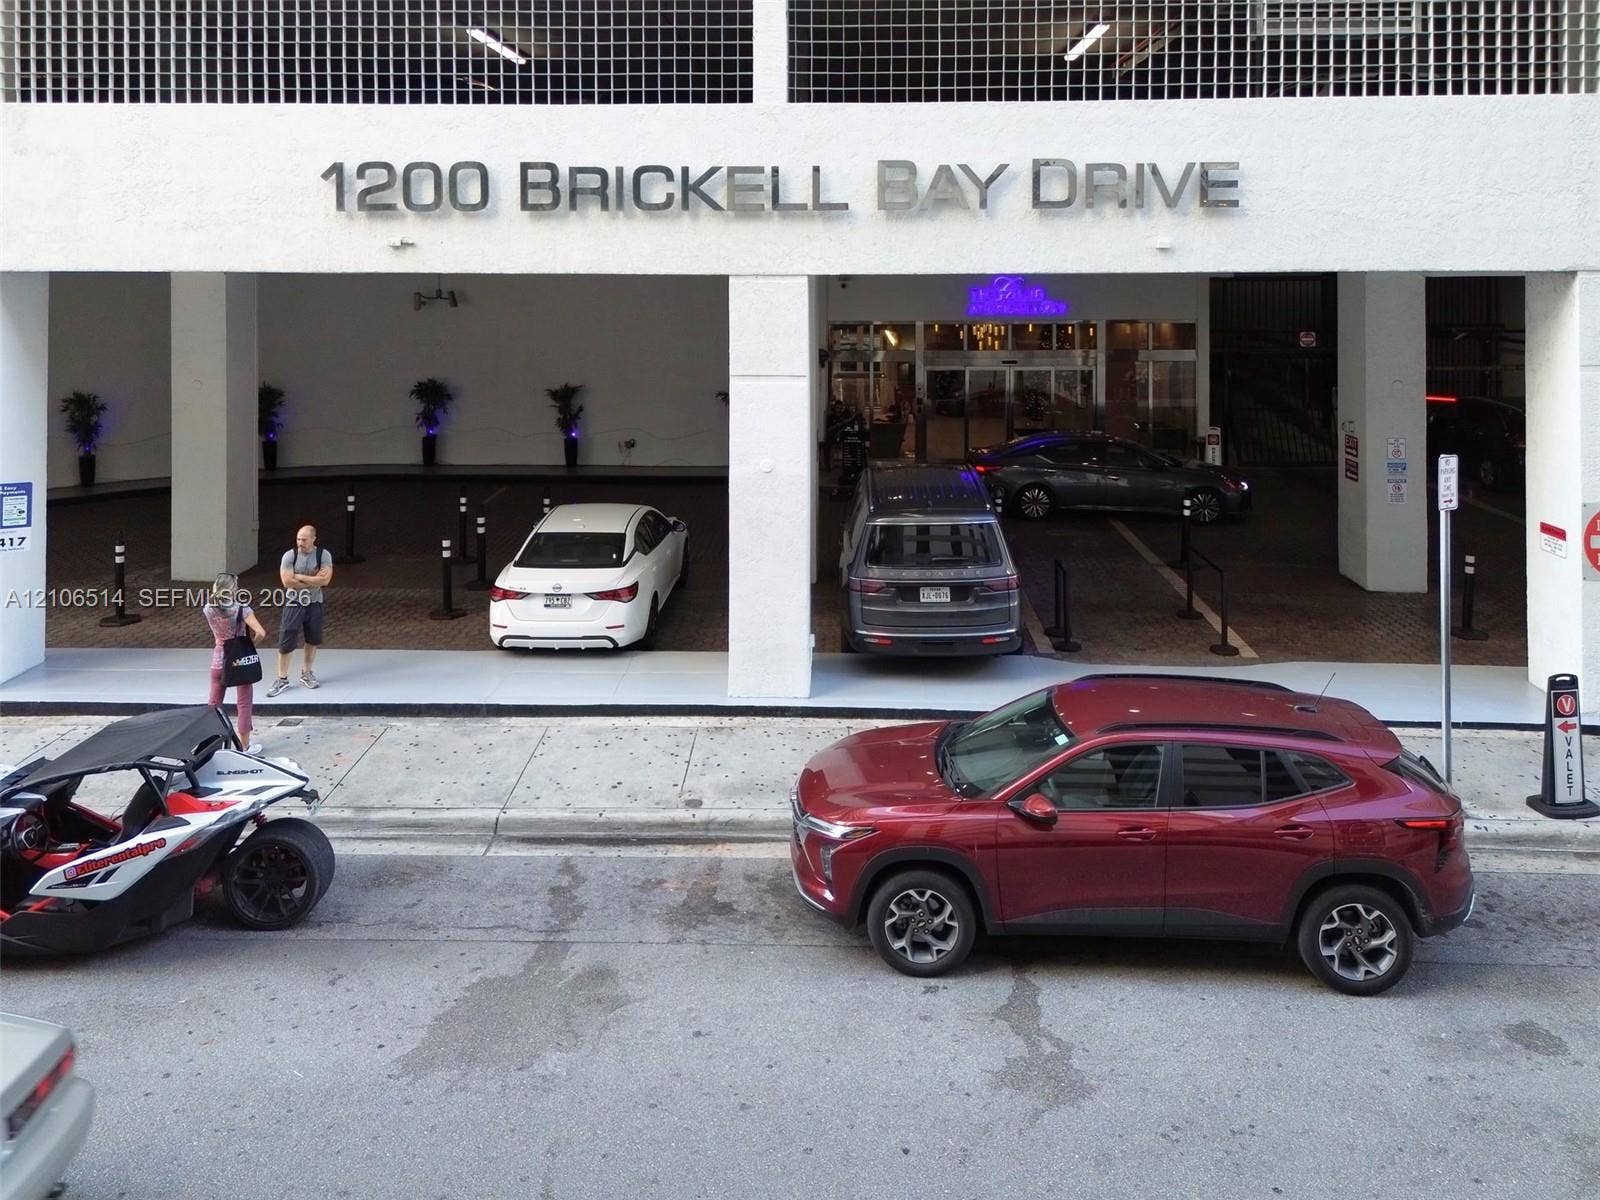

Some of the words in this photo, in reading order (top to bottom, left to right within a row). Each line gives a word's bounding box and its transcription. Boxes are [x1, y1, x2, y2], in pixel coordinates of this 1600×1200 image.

[320, 161, 490, 212] 1200
[519, 161, 849, 212] BRICKELL
[877, 159, 1010, 211] BAY
[1031, 157, 1240, 210] DRIVE
[1561, 698, 1571, 713] V
[216, 768, 264, 776] SLINGSHOT
[1564, 735, 1573, 797] VALET
